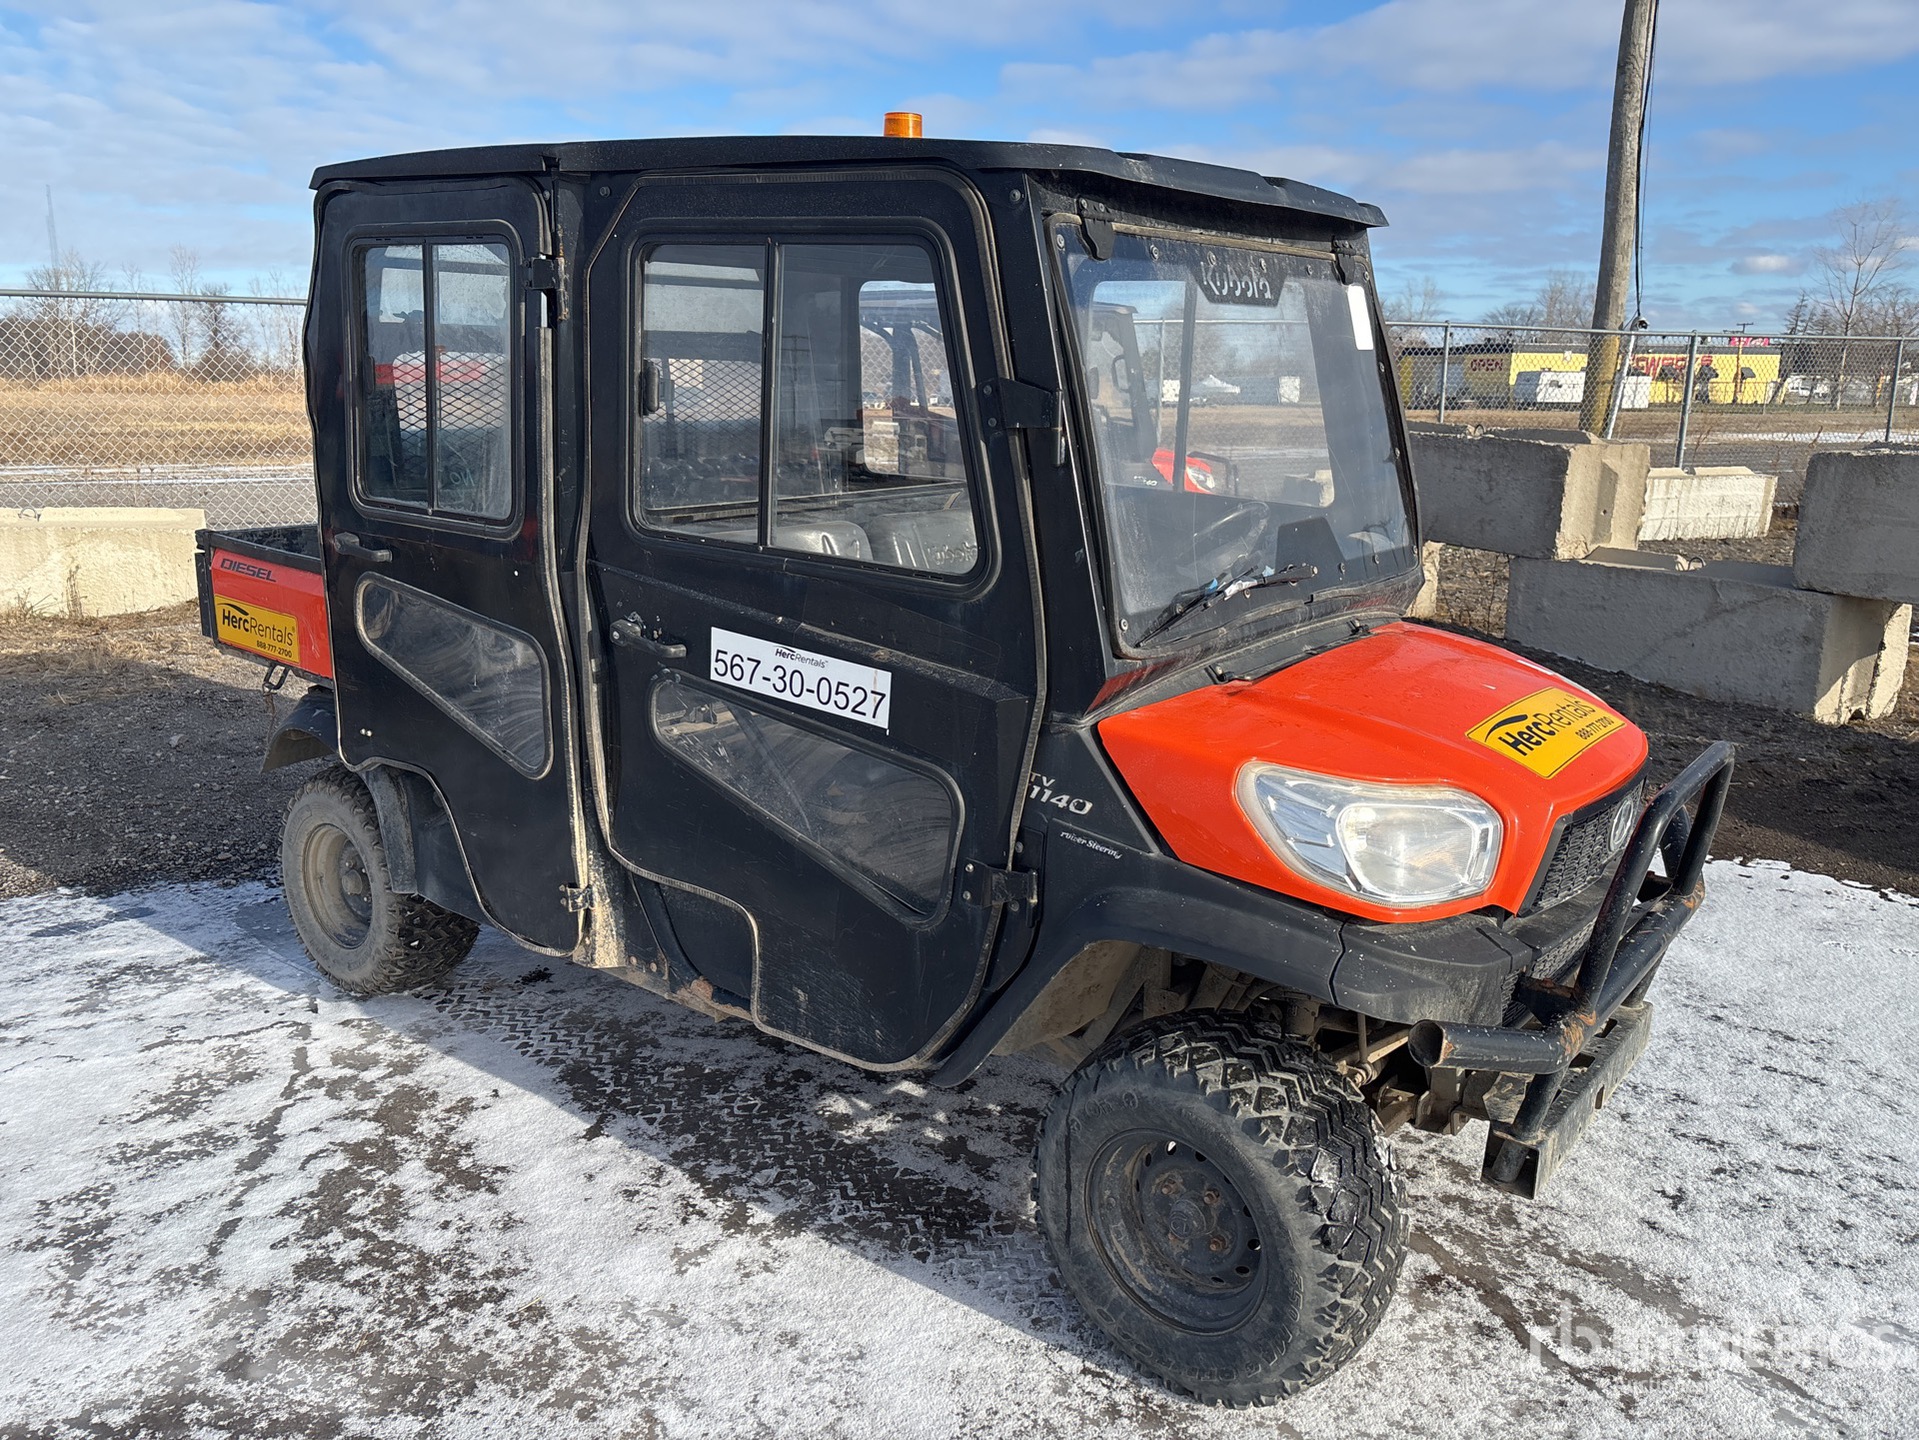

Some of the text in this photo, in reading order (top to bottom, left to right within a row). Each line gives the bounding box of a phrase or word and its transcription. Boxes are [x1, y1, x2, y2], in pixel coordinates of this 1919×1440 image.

[1470, 358, 1504, 372] OPEN
[220, 558, 276, 582] DIESEL
[222, 608, 294, 647] HercRentals
[256, 639, 293, 658] 888-777-2700
[774, 647, 827, 669] HercRentals
[713, 649, 887, 719] 567-30-0527
[1498, 698, 1597, 757] HercRentals
